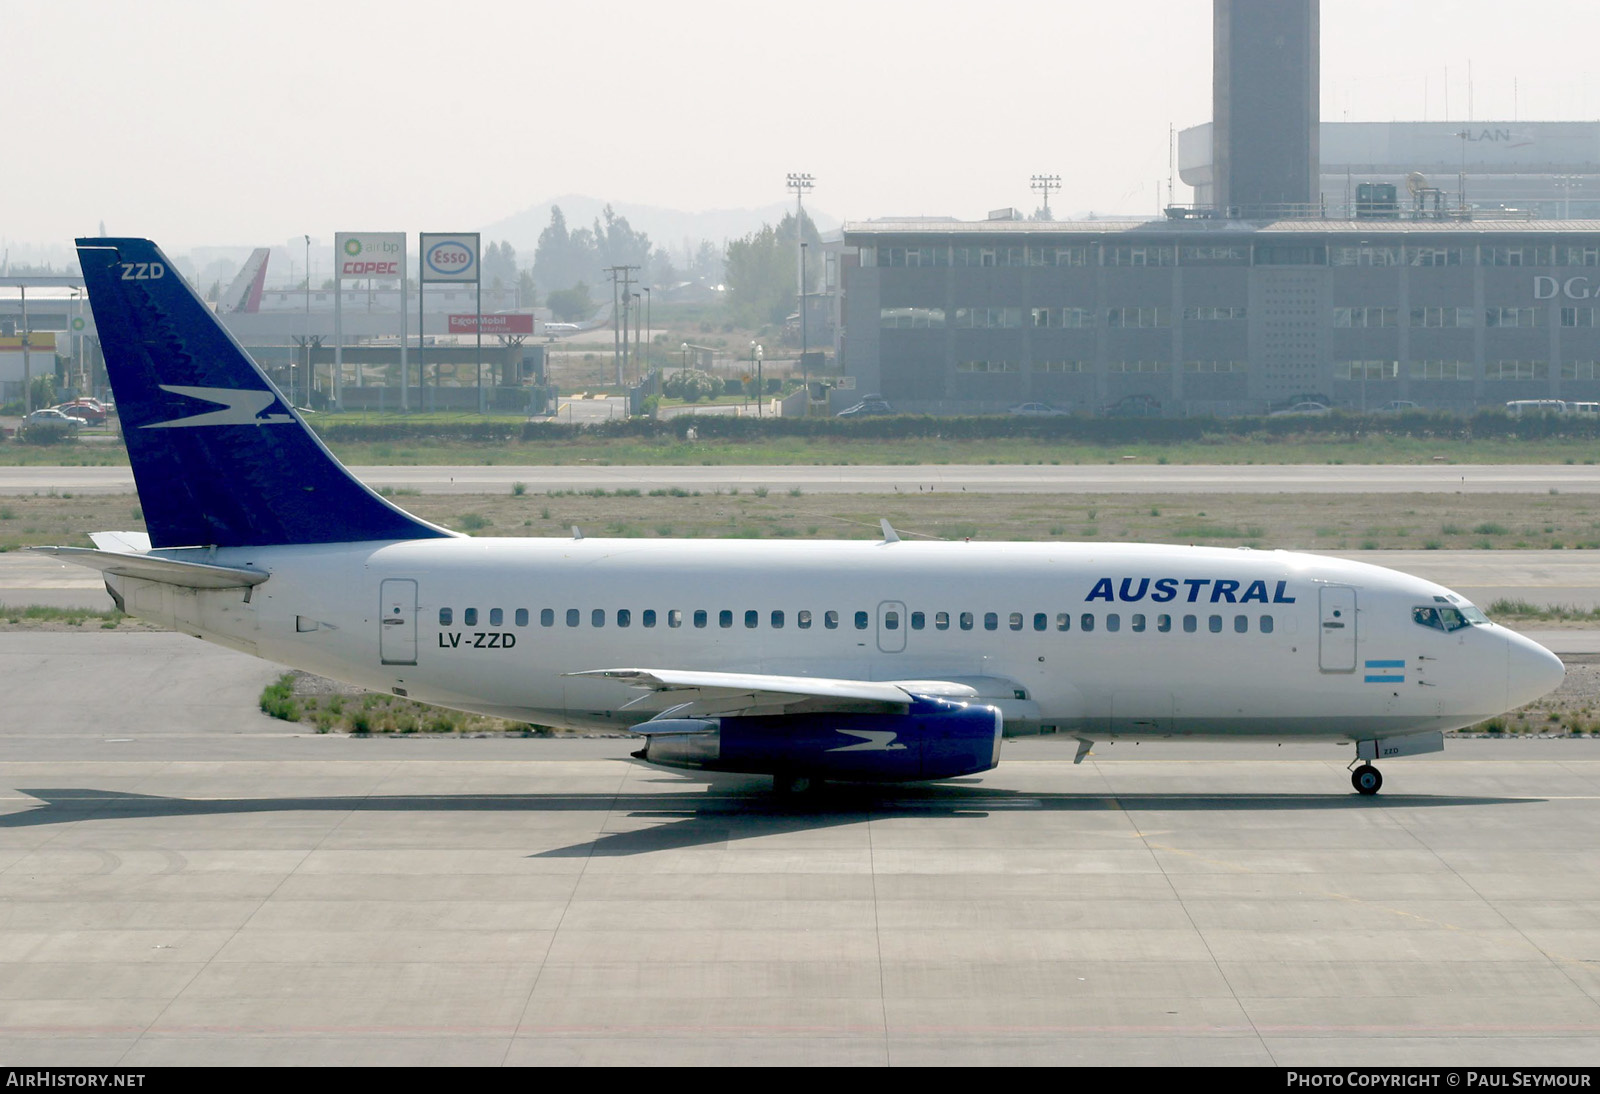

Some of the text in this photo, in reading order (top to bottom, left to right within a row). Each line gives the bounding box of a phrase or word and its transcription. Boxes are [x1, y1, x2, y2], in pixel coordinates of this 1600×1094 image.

[1467, 129, 1509, 142] LAN
[121, 262, 165, 280] ZZD
[1084, 577, 1296, 604] AUSTRAL
[439, 632, 517, 649] LV-ZZD
[1384, 747, 1399, 755] ZZD
